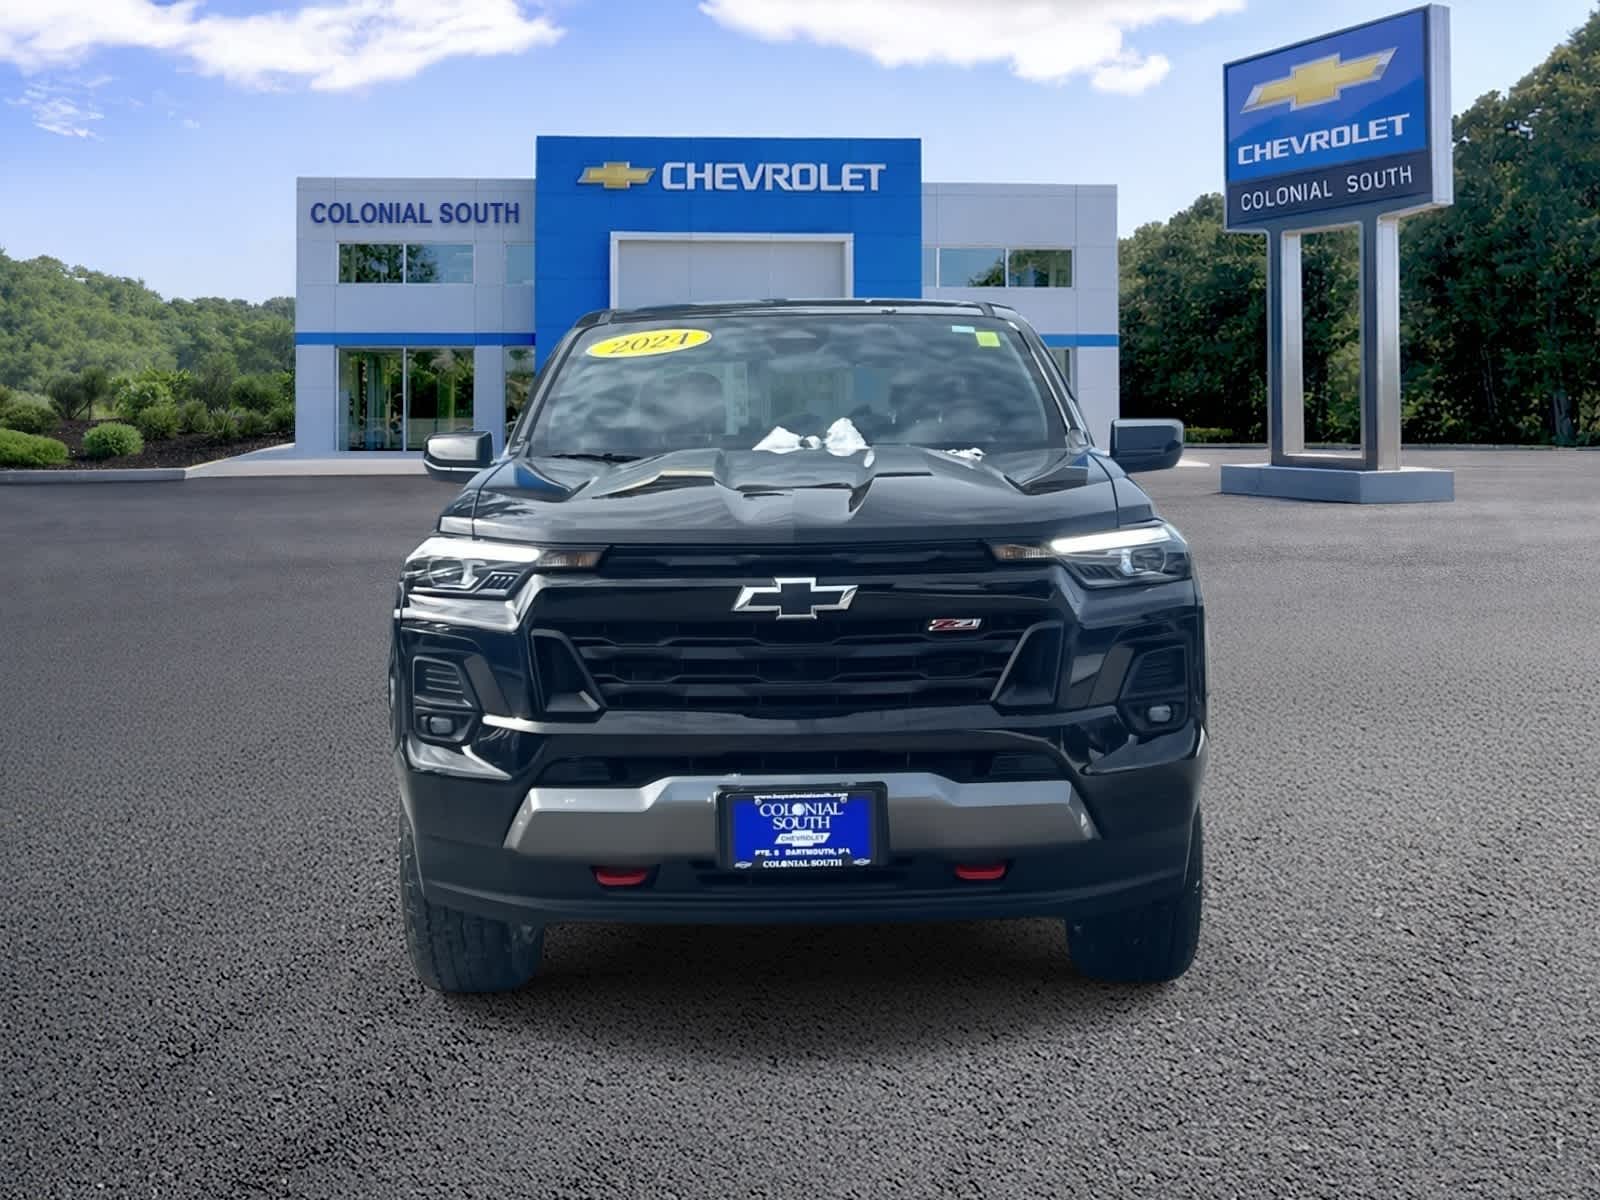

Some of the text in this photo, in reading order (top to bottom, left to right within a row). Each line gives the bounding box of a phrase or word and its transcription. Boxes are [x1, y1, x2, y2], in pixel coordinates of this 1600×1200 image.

[1238, 113, 1410, 165] CHEVROLET
[662, 162, 887, 191] CHEVROLET
[1240, 165, 1413, 211] COLONIAL SOUTH
[310, 202, 520, 224] COLONIAL SOUTH
[609, 332, 689, 353] 2024
[760, 803, 843, 816] COLONIAL
[772, 816, 830, 830] SOUTH
[780, 834, 825, 842] CHEVROLET
[763, 859, 842, 868] COLONIAL SOUTH
